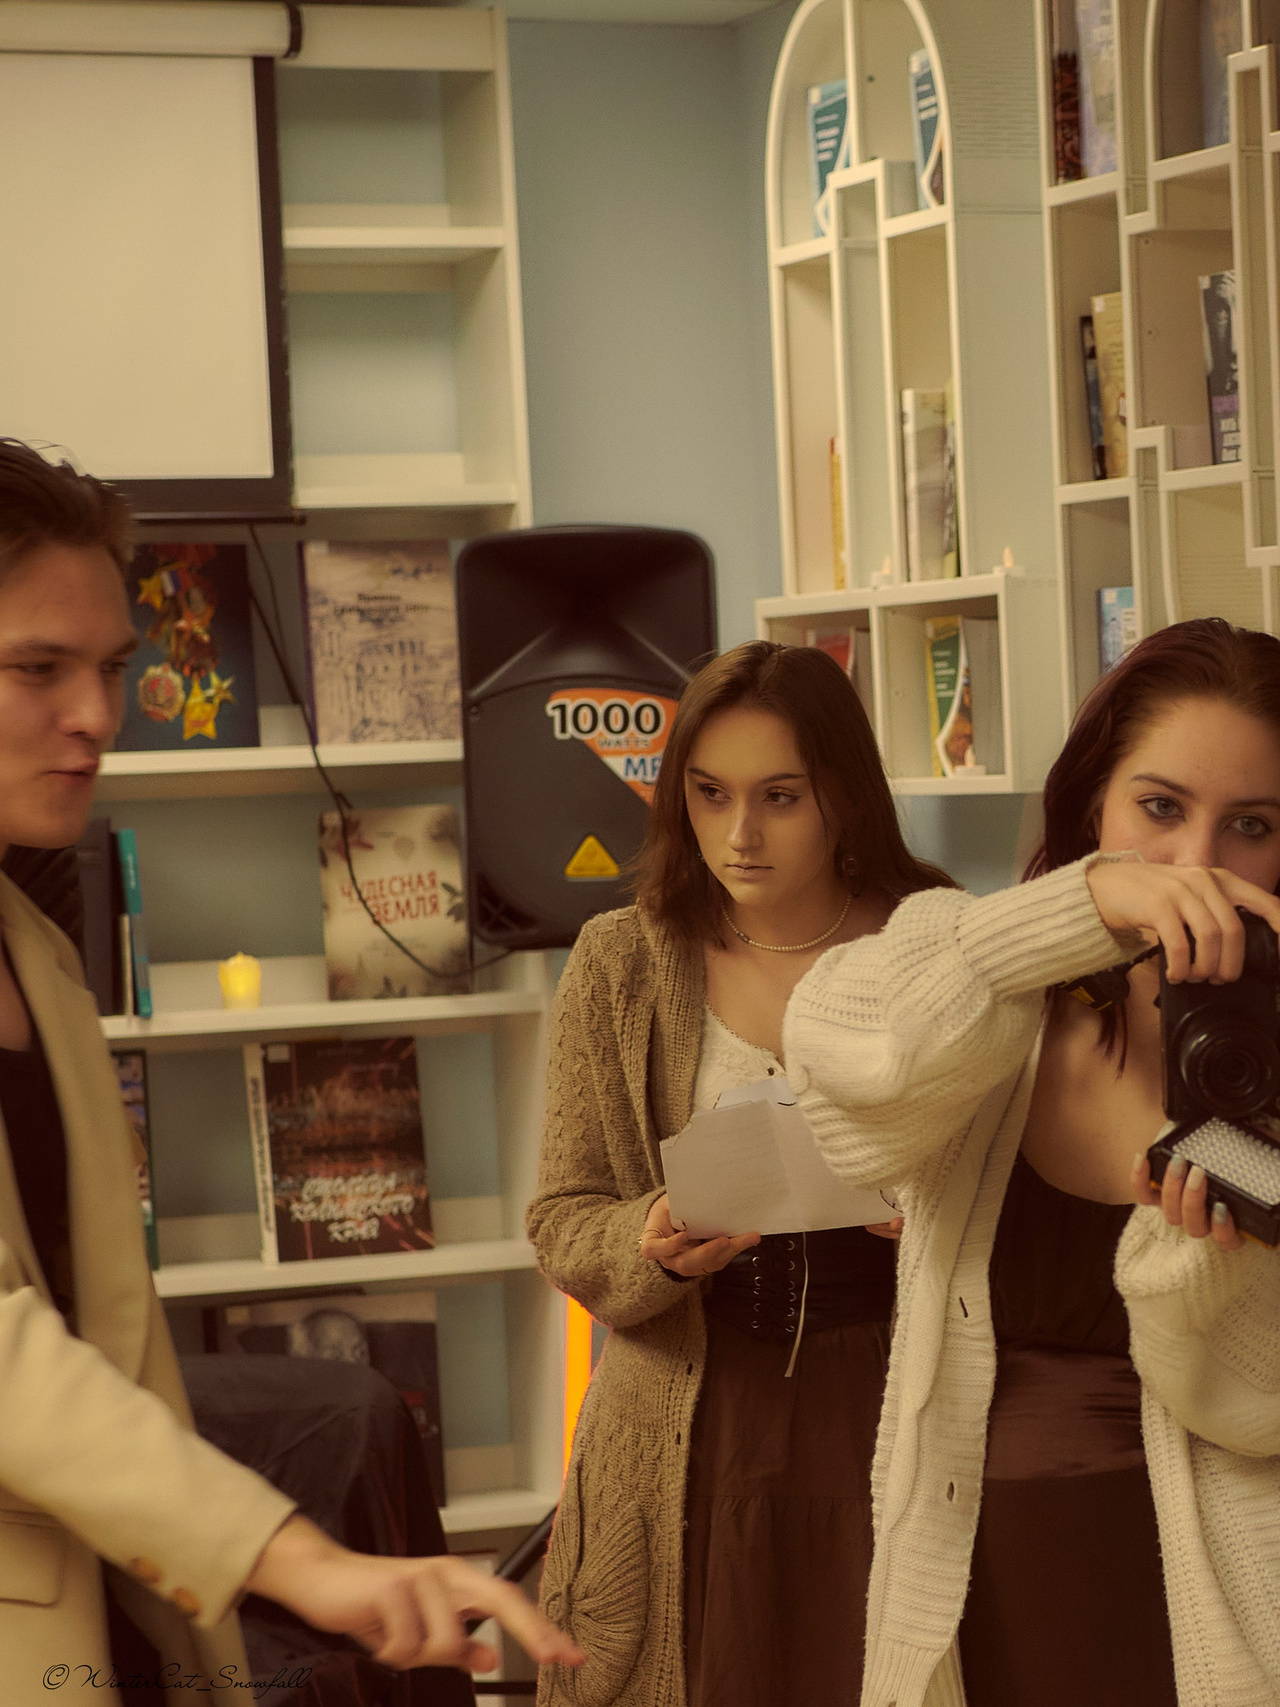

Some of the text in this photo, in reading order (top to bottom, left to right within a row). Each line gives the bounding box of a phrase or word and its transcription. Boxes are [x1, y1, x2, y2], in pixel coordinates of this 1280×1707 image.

[548, 700, 663, 737] 1000
[599, 738, 651, 750] WATTS
[371, 893, 439, 926] ЗЕМЛЯ
